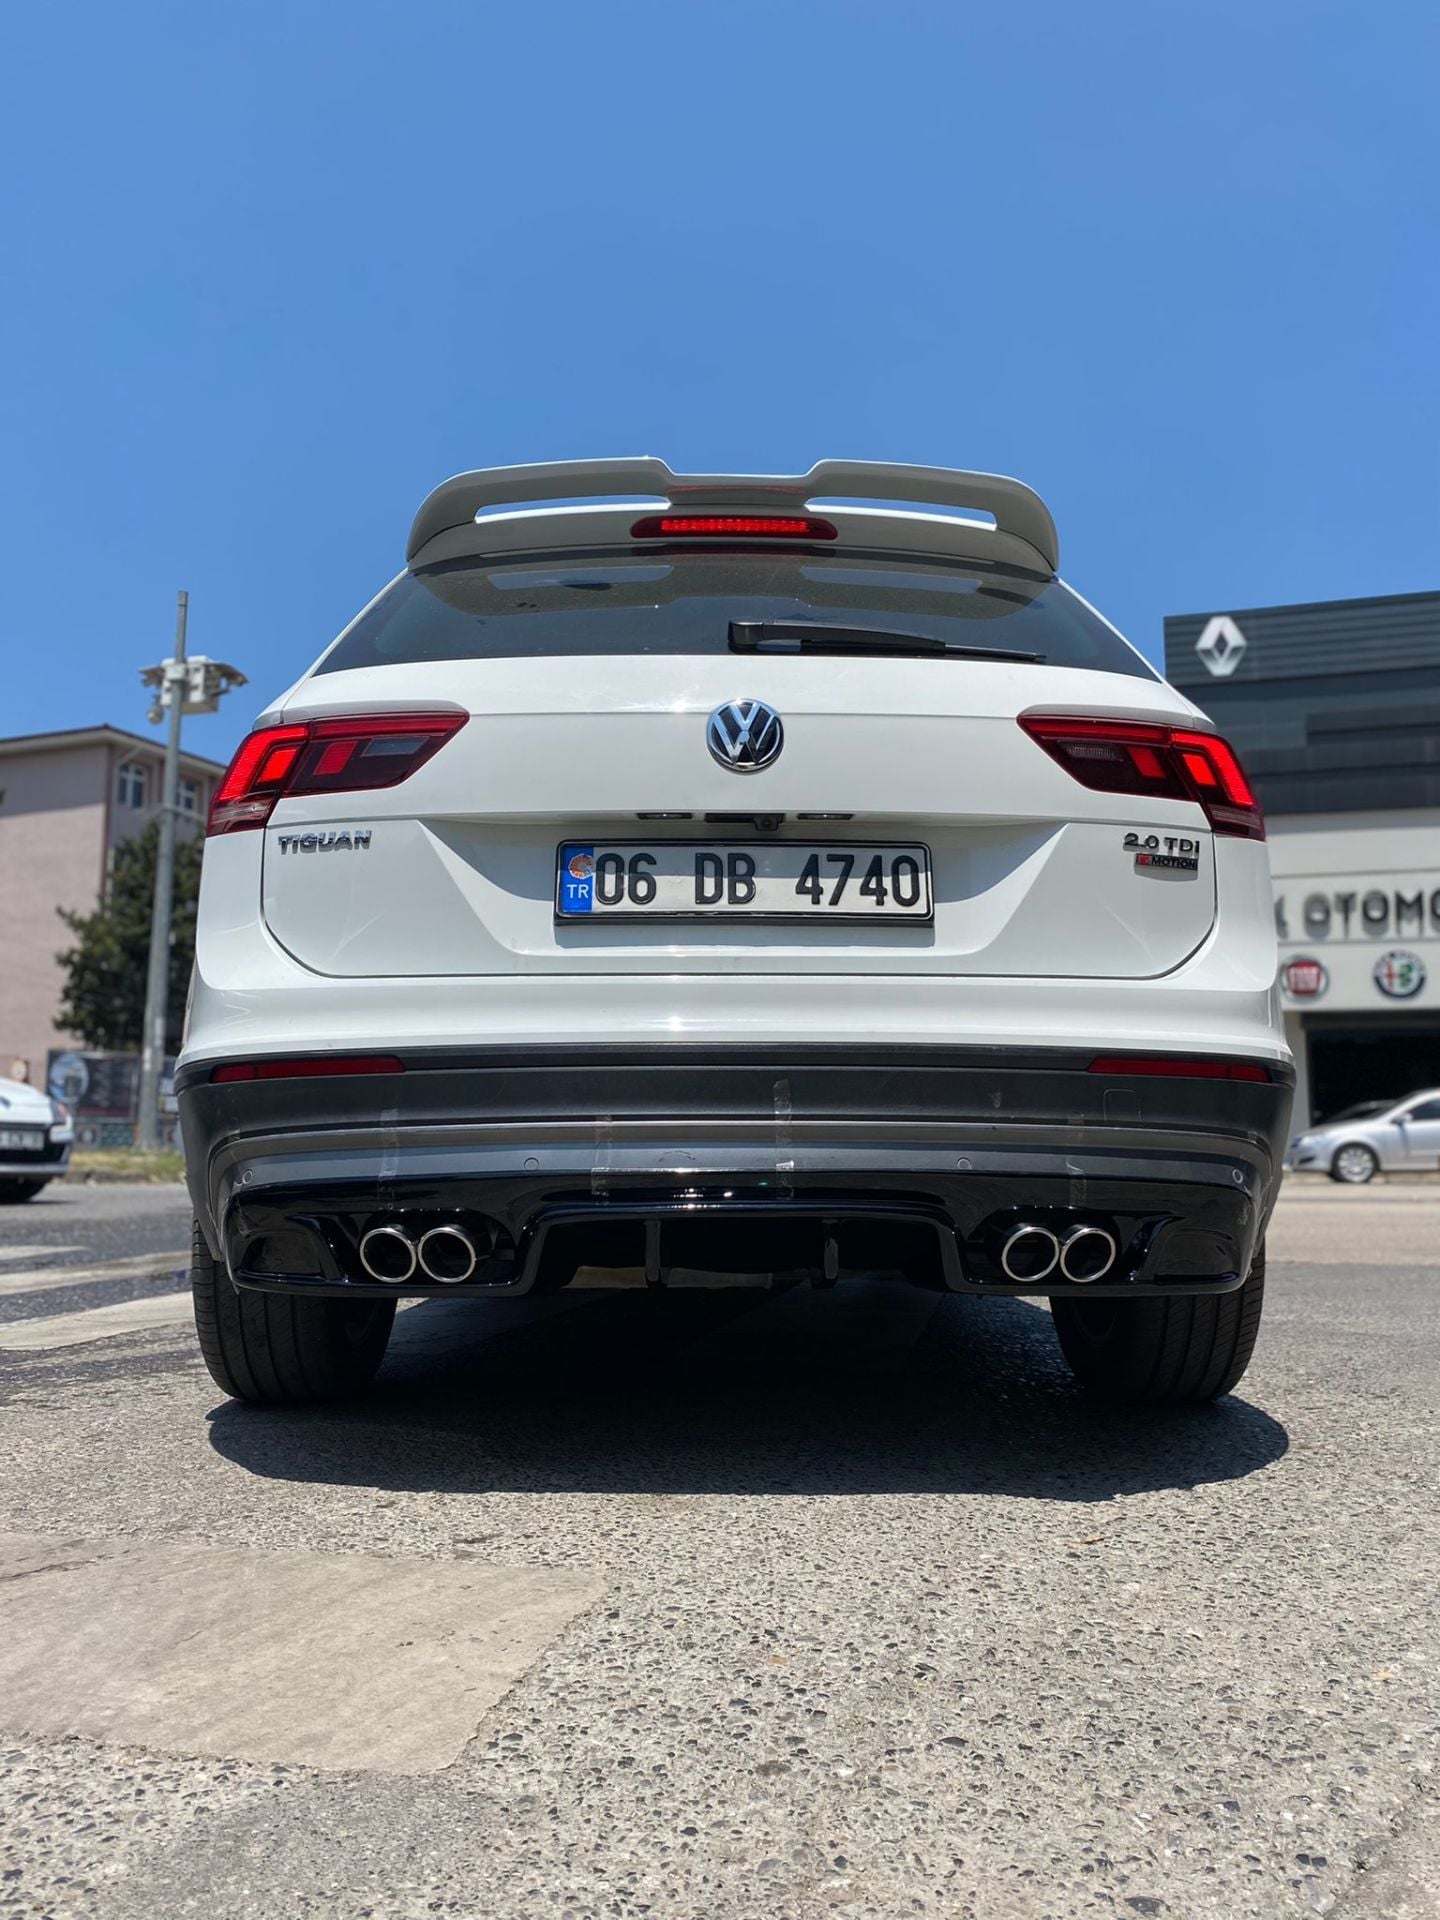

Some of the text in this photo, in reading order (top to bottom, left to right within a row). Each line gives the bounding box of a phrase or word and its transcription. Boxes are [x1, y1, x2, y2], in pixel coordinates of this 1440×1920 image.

[278, 830, 372, 855] TIGUAN
[1164, 837, 1200, 857] TDI
[595, 853, 921, 906] 06 DB 4740
[566, 883, 590, 899] TR
